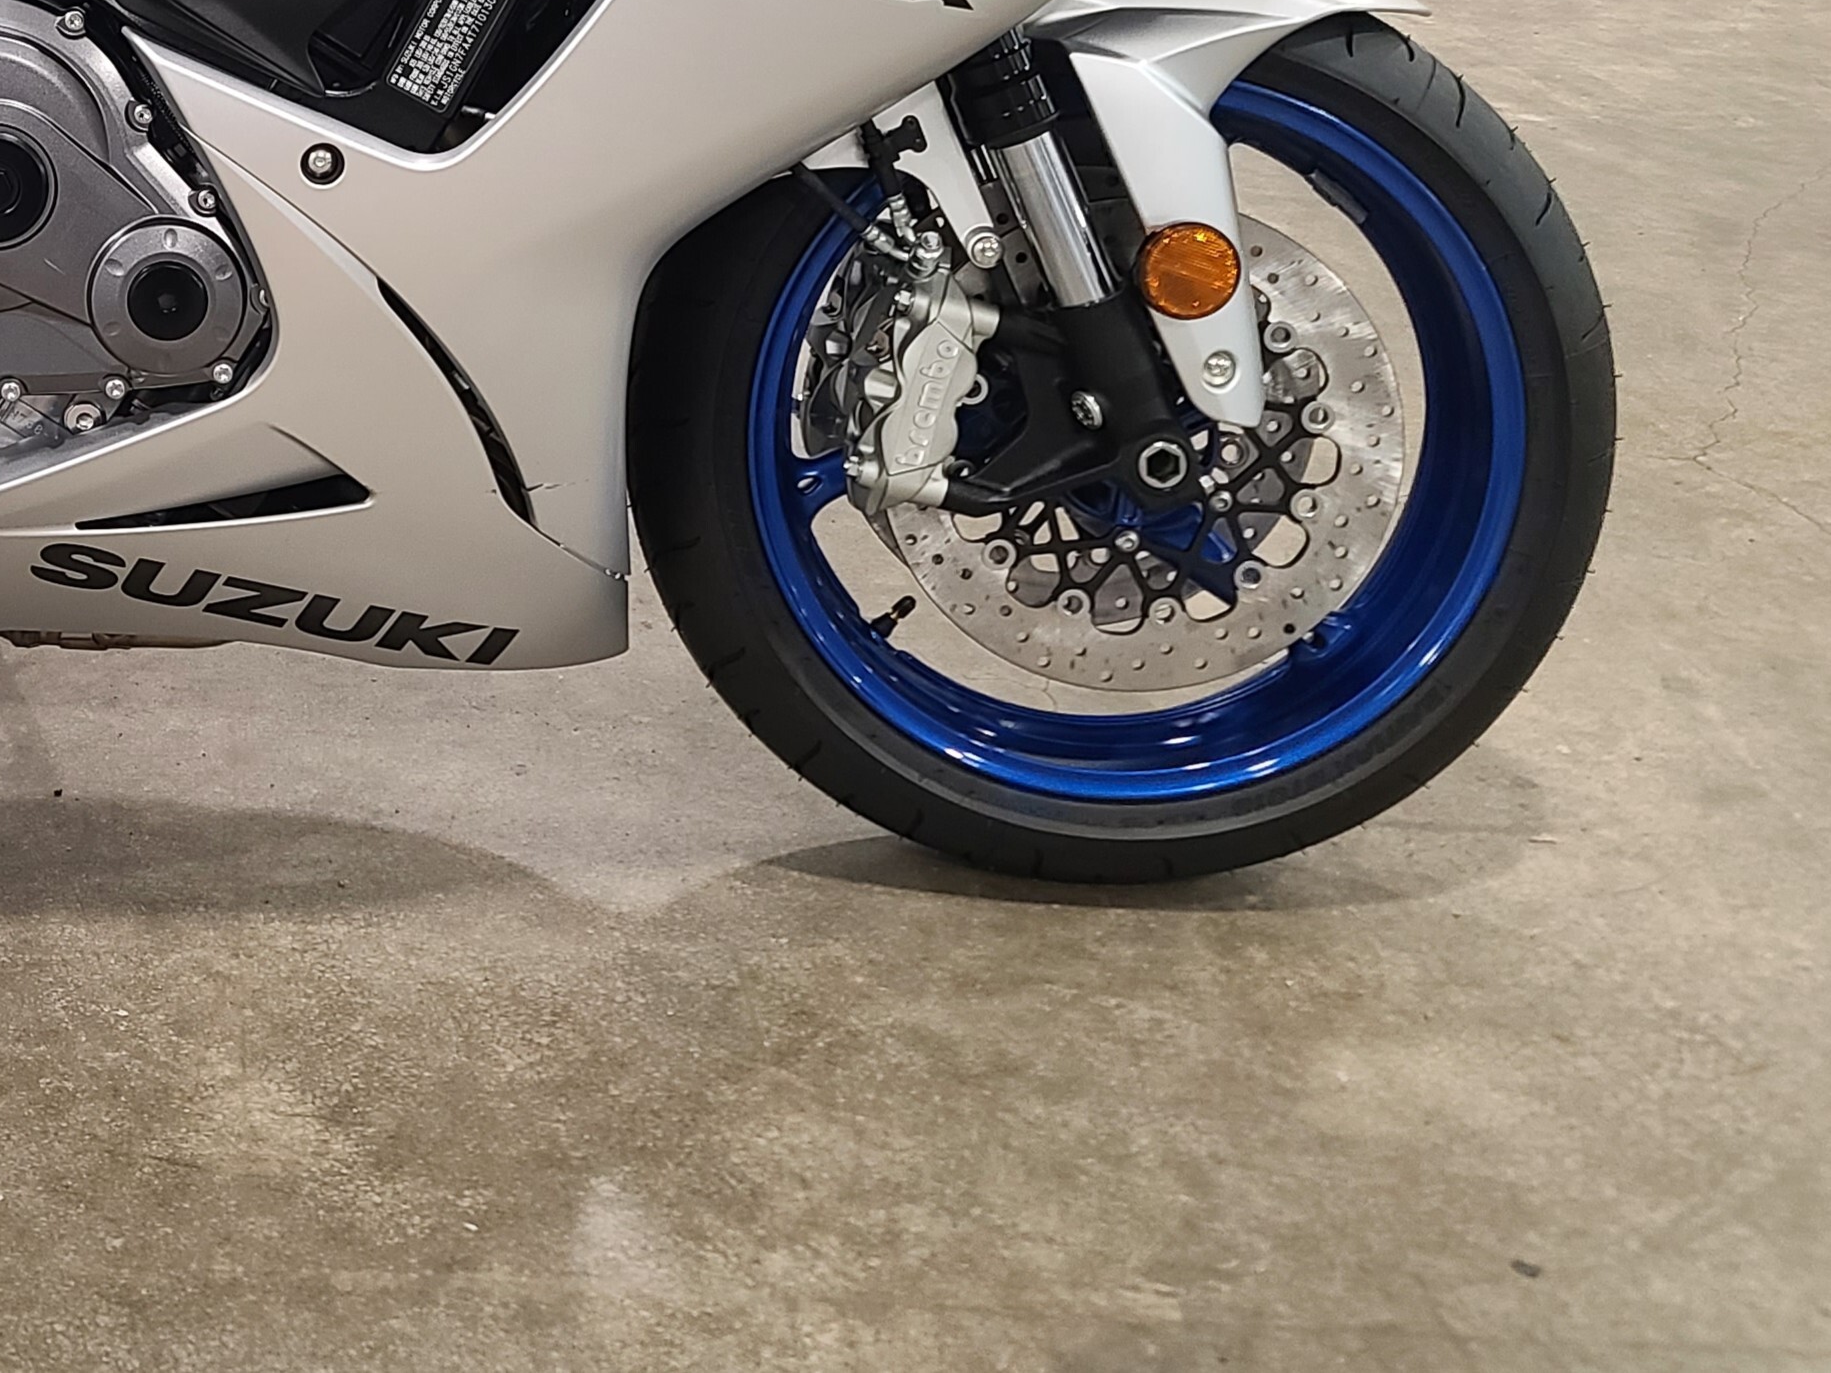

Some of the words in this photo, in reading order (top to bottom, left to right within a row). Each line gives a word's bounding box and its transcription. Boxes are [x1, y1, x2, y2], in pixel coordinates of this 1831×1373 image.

[415, 18, 429, 38] MOTOR
[895, 339, 960, 467] brembo
[30, 542, 520, 666] SUZUKI
